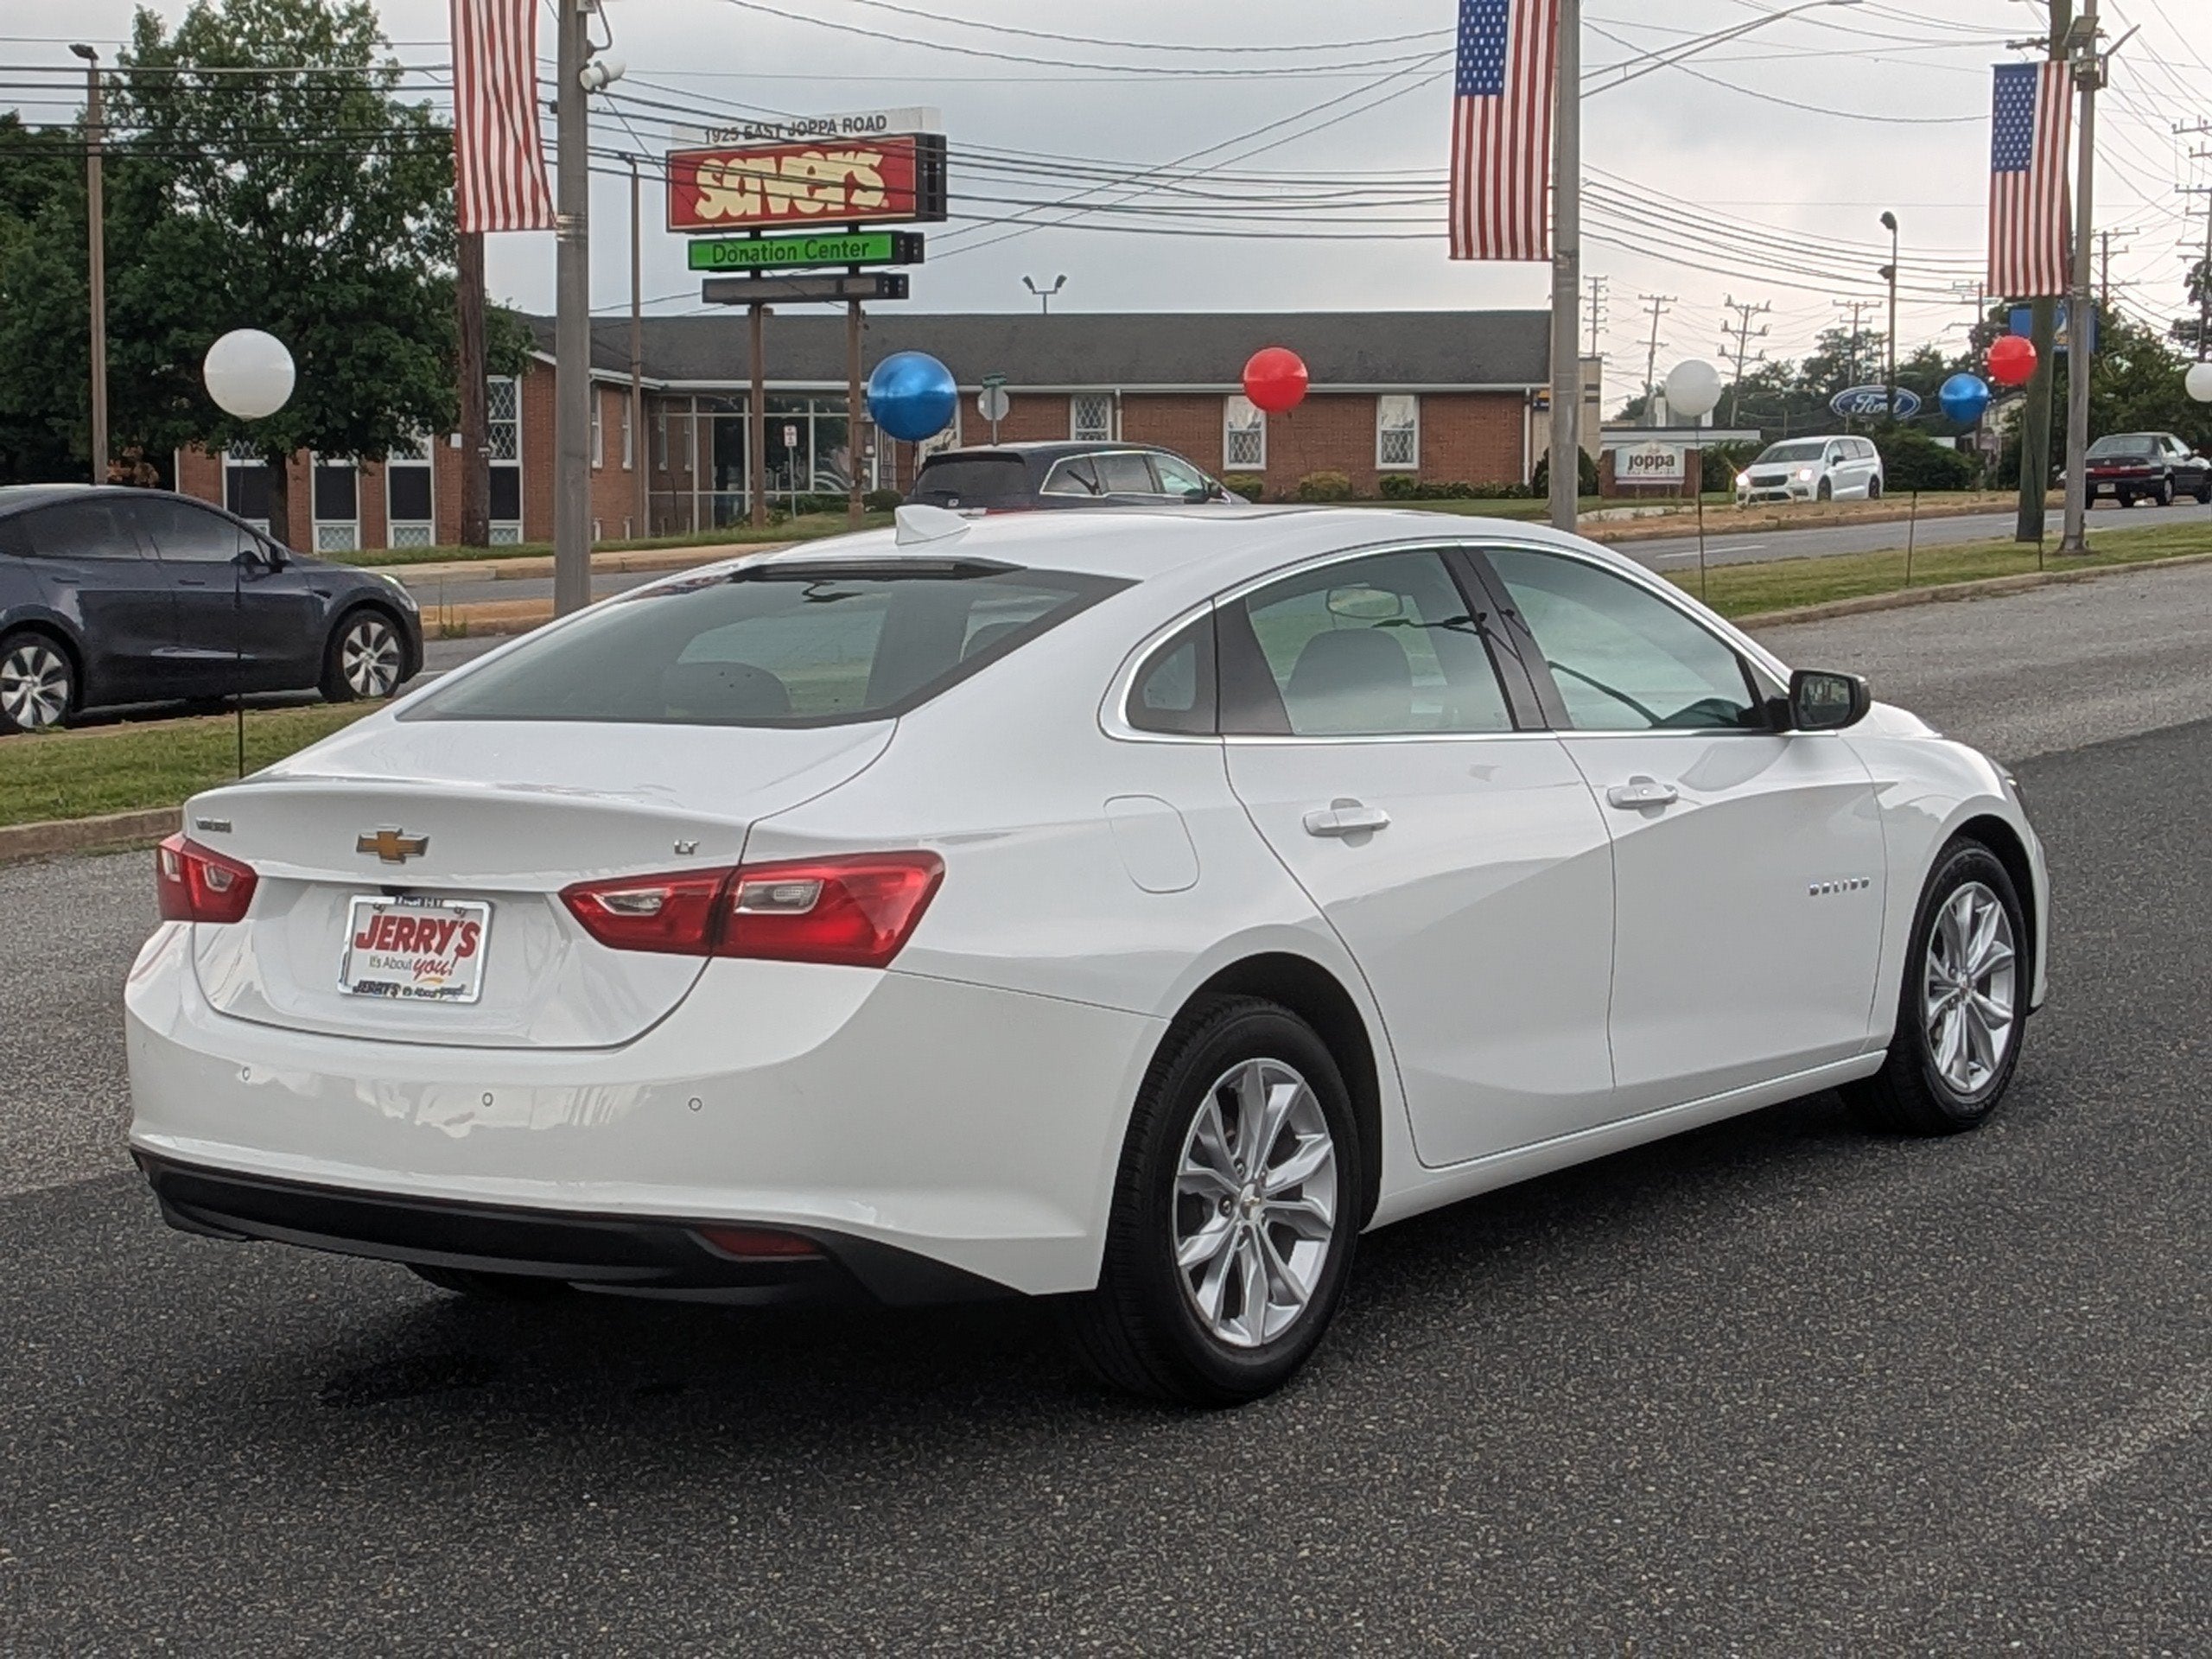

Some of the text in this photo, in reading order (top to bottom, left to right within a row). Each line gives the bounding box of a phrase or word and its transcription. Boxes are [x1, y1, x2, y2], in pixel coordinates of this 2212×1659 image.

[705, 114, 887, 144] 1925 EAST JOPPA ROAD
[712, 239, 870, 264] Donation Center
[1627, 454, 1675, 471] joppa
[353, 914, 481, 958] JERRY'S
[383, 956, 413, 971] About
[412, 954, 459, 982] you!
